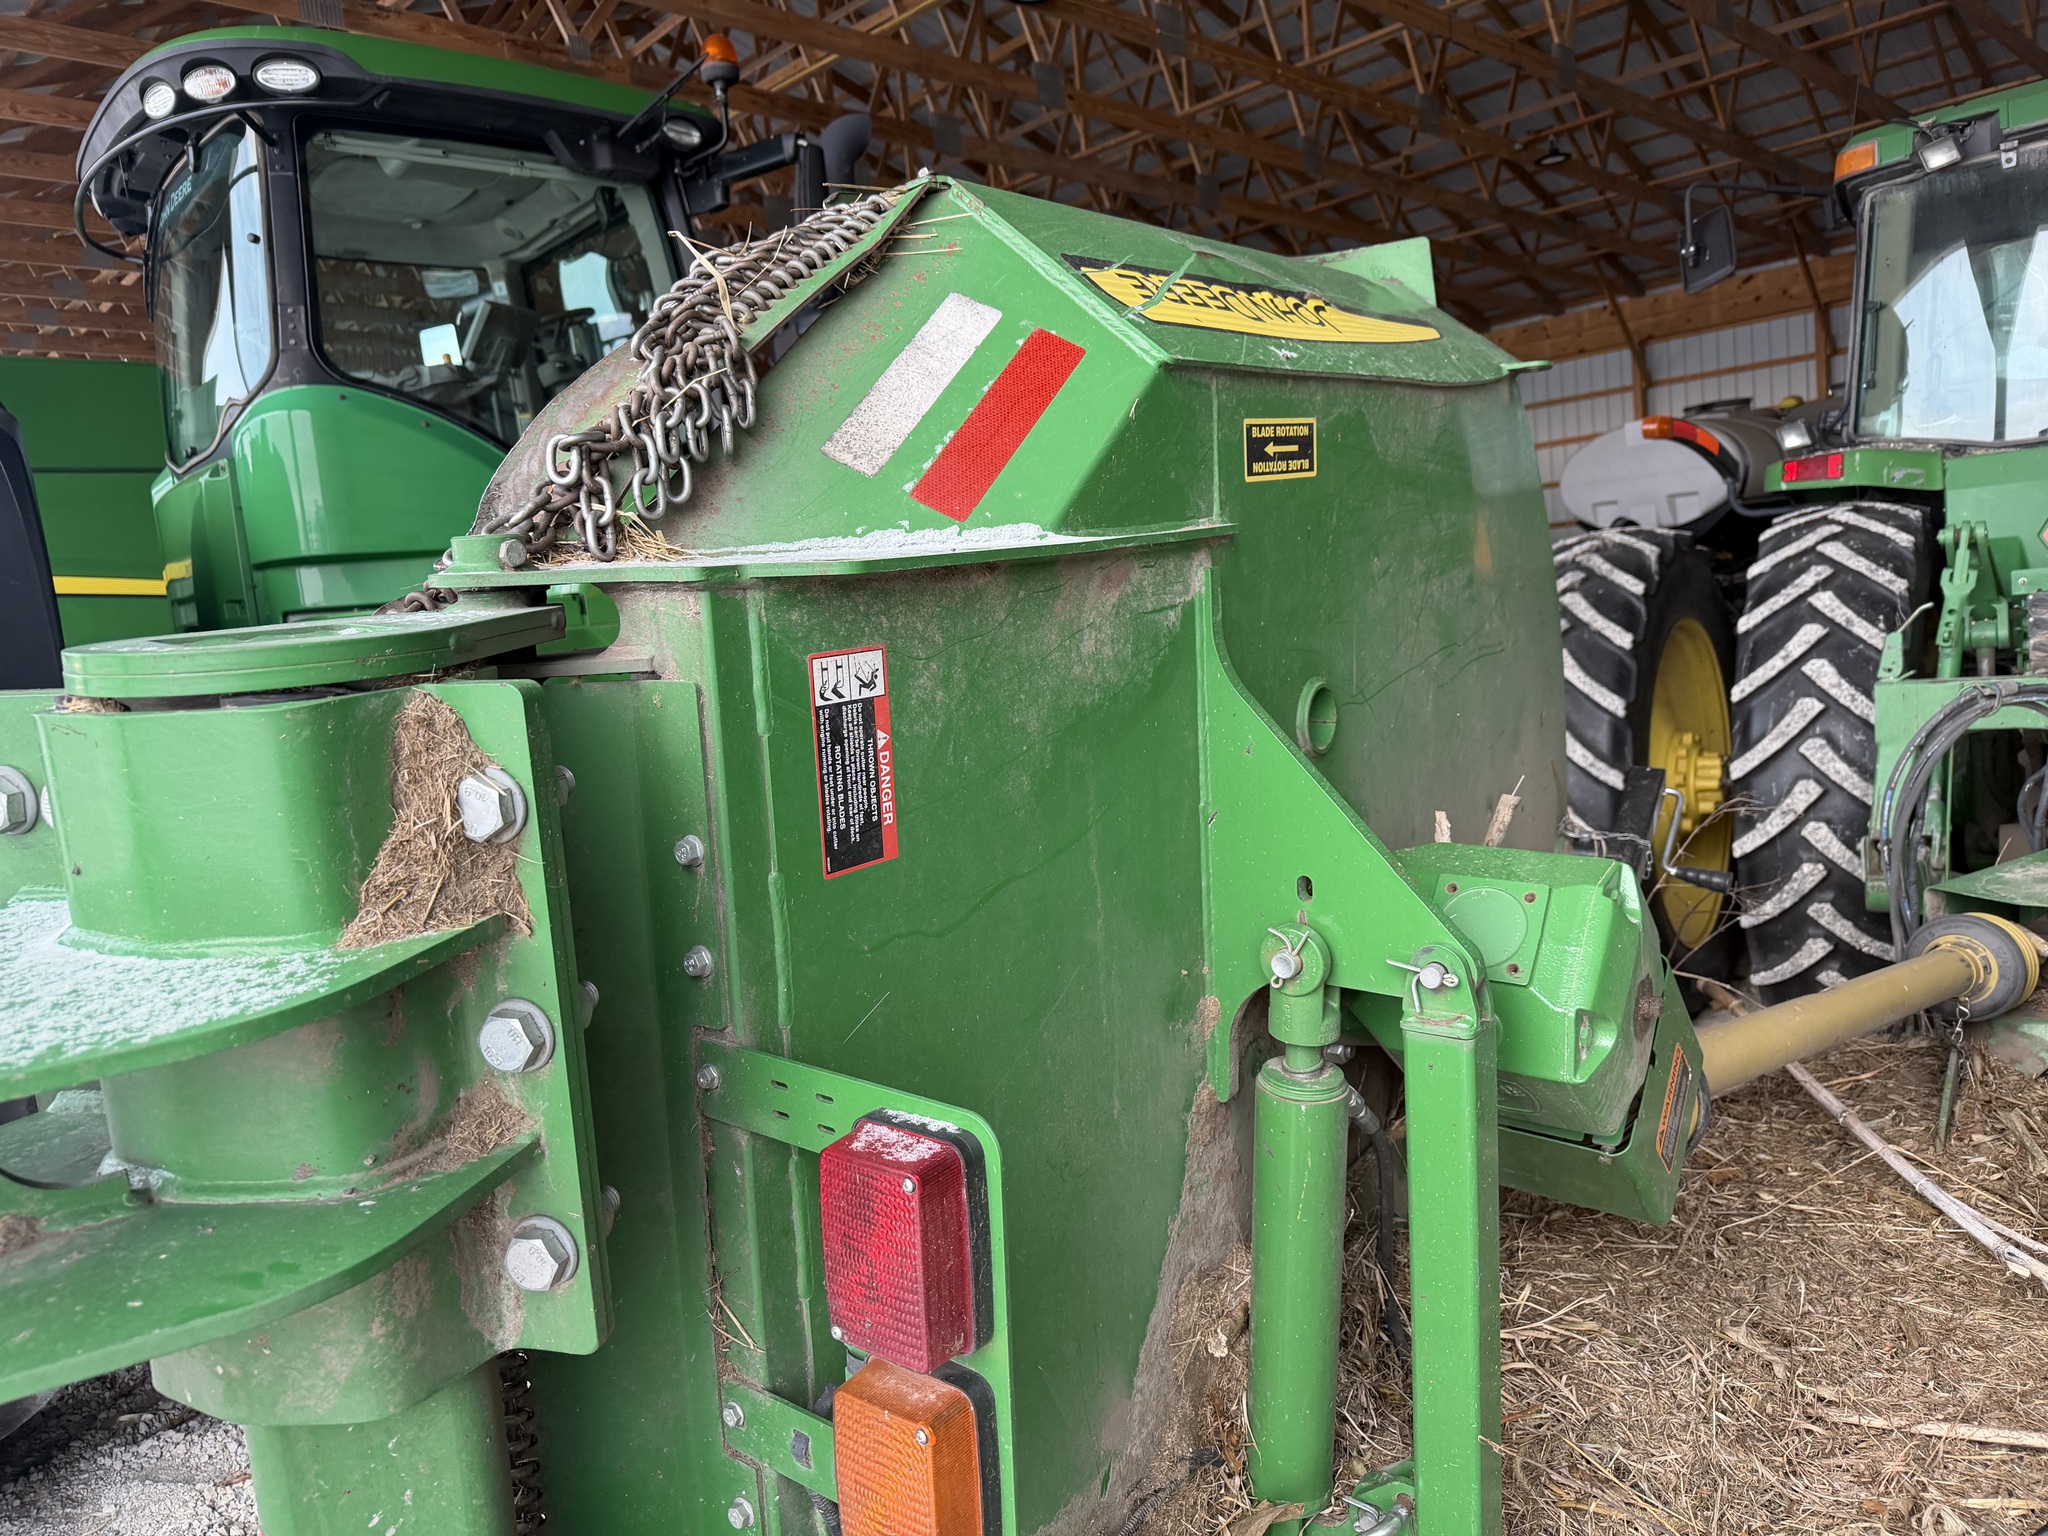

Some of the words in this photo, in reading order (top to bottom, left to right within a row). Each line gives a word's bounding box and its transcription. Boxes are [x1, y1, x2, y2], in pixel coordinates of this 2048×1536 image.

[171, 175, 192, 212] DEERE
[1115, 272, 1265, 323] DEERE
[1248, 292, 1342, 333] JOHN
[1252, 426, 1275, 438] BLADE
[1276, 425, 1309, 437] ROTATION
[1253, 460, 1287, 473] ROTATION
[1288, 459, 1310, 471] BLADE
[824, 709, 830, 719] Do
[858, 703, 863, 712] Do
[835, 746, 844, 791] ROTATING
[867, 739, 875, 779] THROWN
[823, 775, 828, 783] or
[879, 751, 894, 825] DANGER
[838, 794, 846, 830] BLADES
[870, 781, 878, 822] OBJECTS
[855, 834, 860, 842] on
[1662, 1047, 1681, 1126] WARNING
